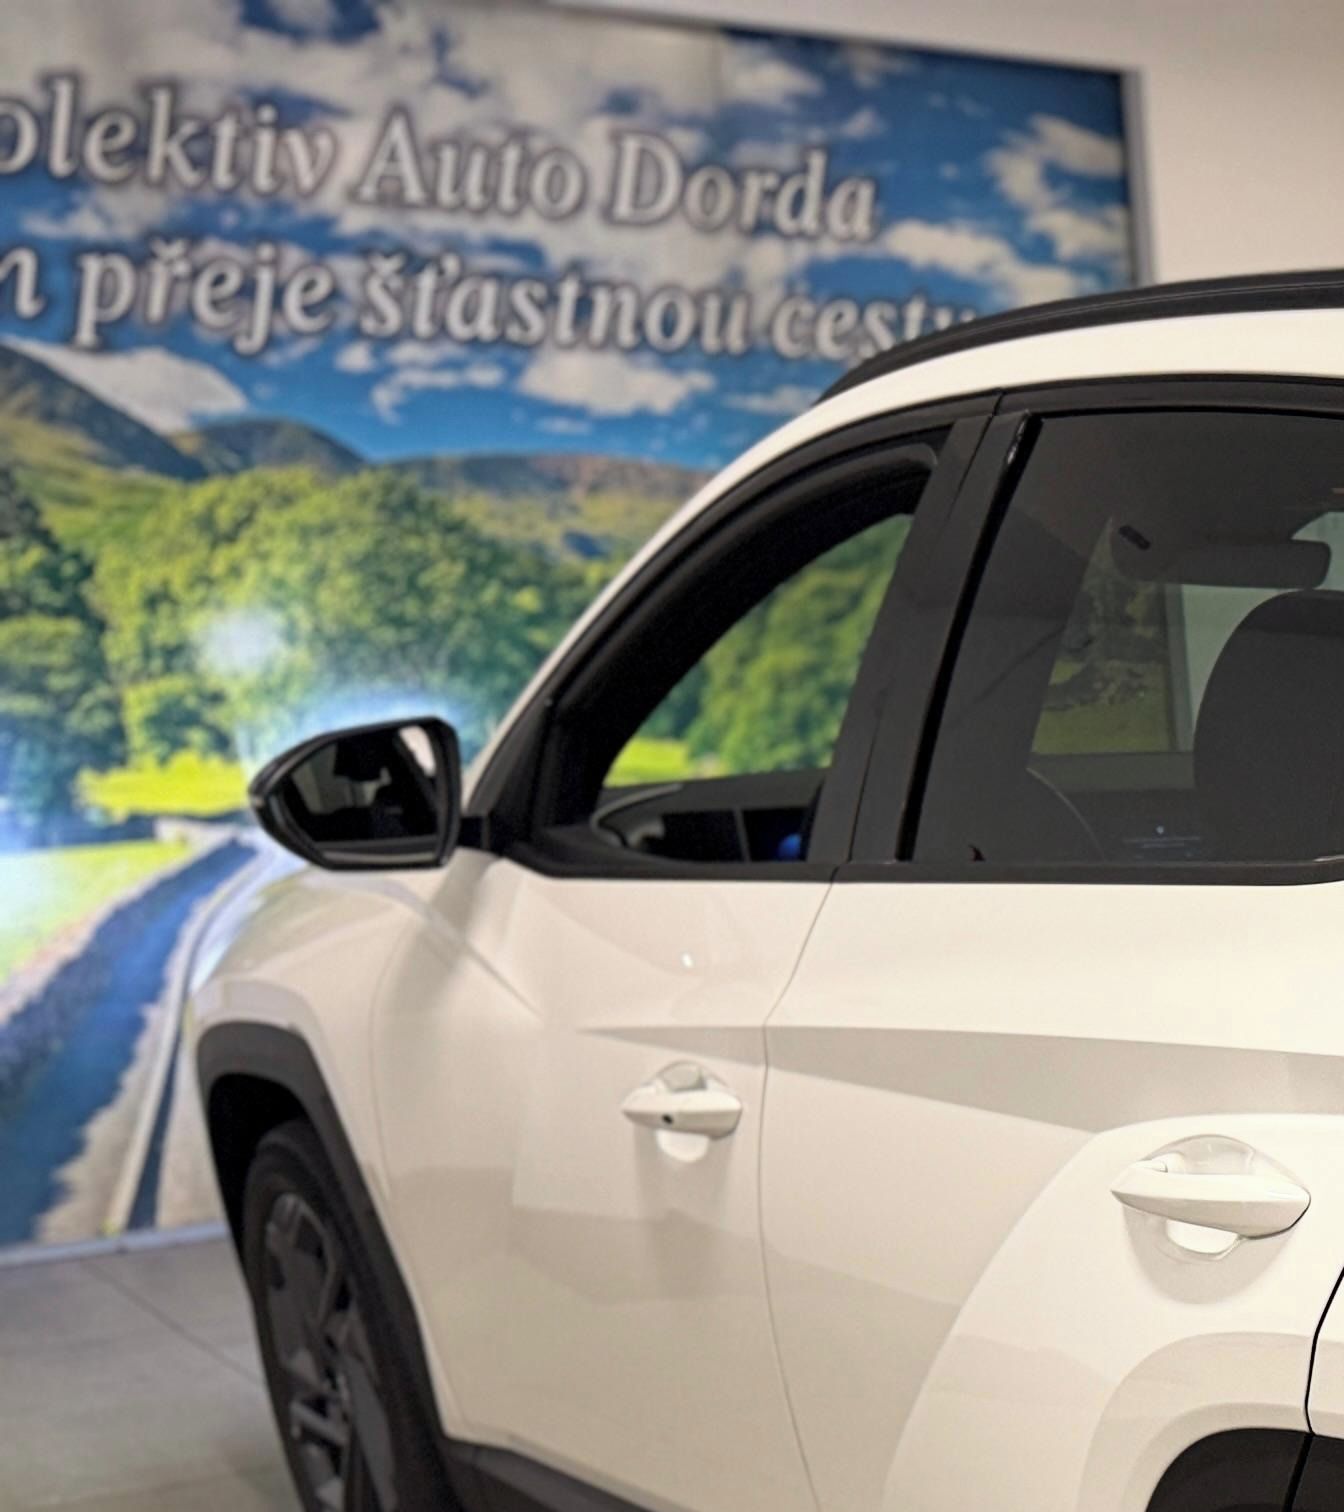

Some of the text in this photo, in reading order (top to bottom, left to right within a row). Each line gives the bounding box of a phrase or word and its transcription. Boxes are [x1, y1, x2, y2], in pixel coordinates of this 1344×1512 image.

[354, 107, 585, 218] Auto
[609, 132, 877, 241] Dorda
[76, 237, 336, 355] přeje
[359, 252, 750, 354] šťastnou
